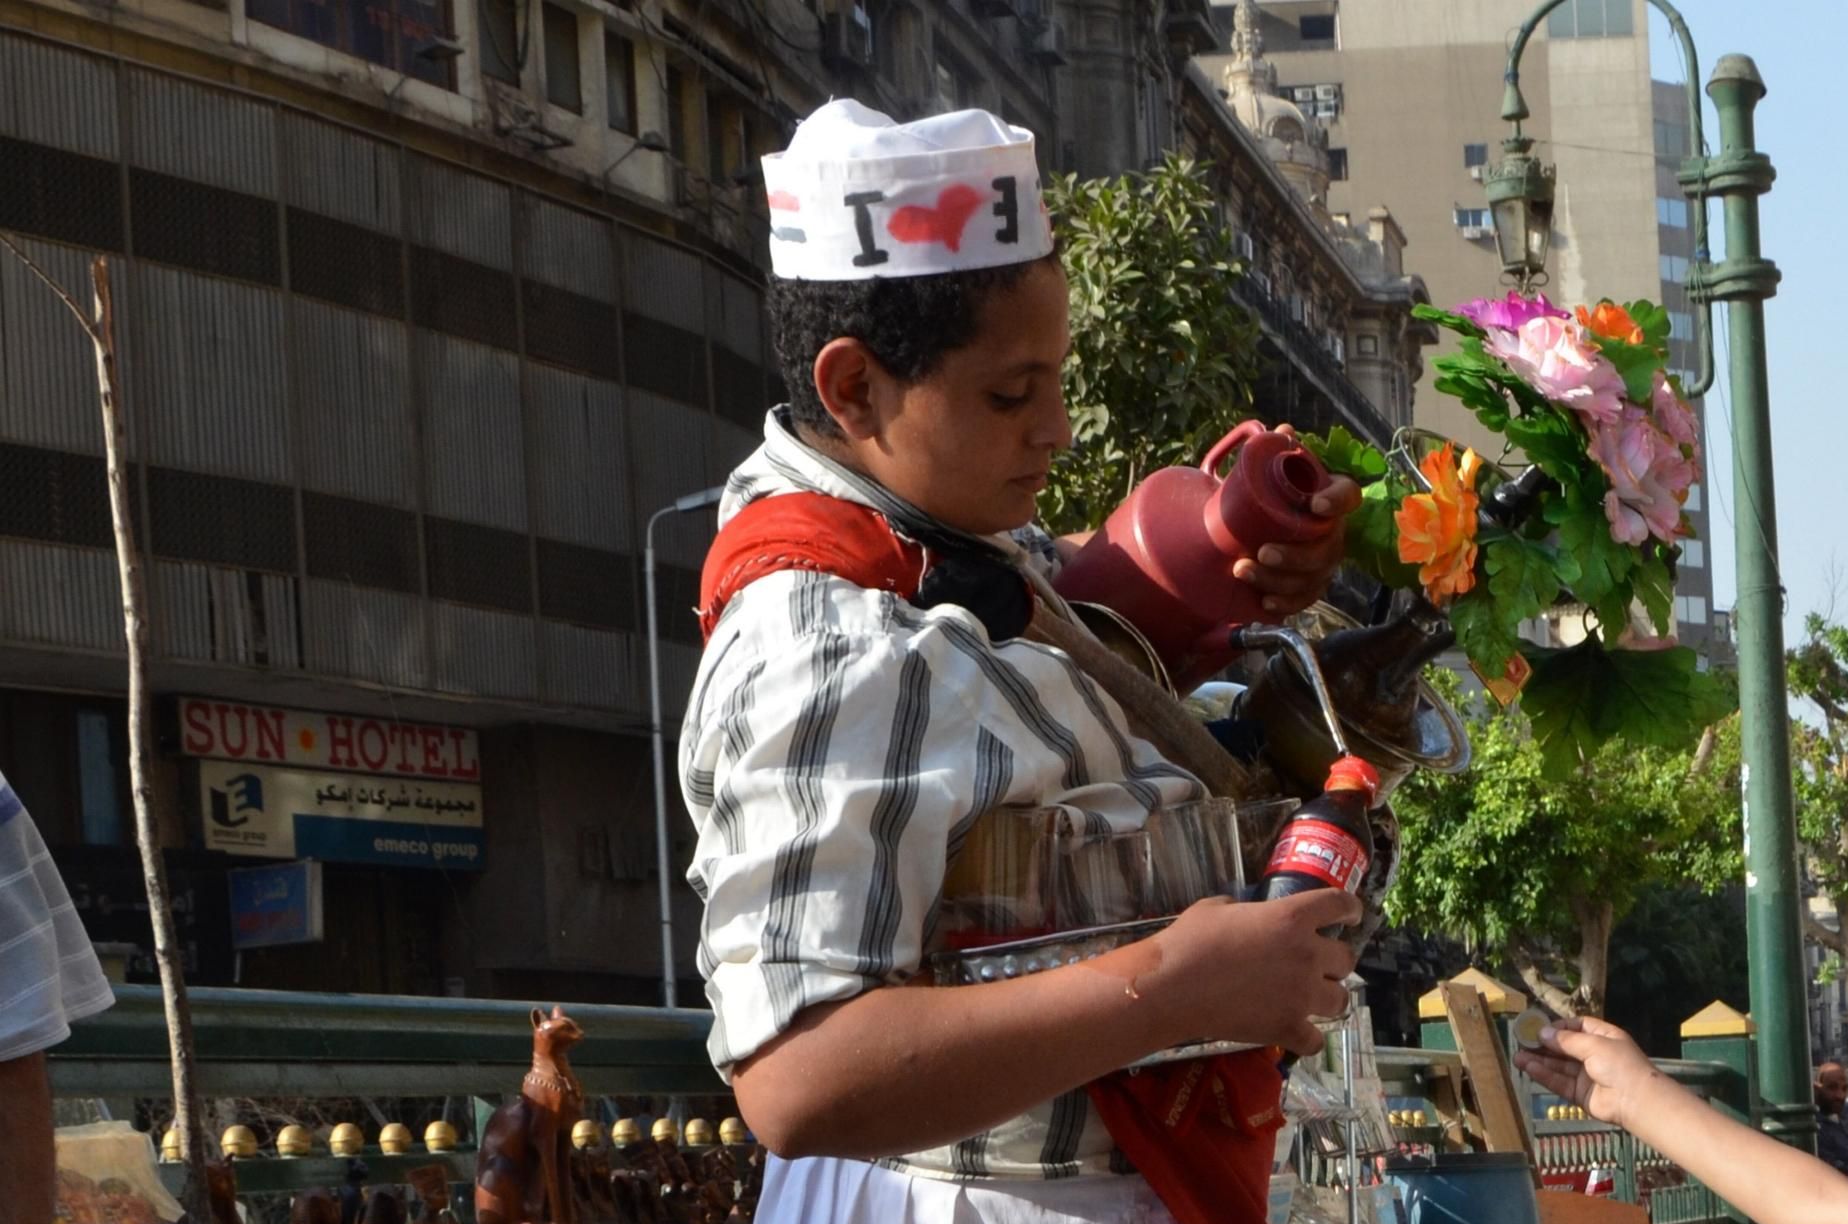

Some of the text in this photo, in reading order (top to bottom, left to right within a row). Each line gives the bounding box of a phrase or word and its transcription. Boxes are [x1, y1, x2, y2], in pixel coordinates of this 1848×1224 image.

[186, 702, 478, 779] SUN HOTEL
[359, 784, 409, 811] شركات
[415, 788, 476, 818] مجموعة
[373, 837, 479, 864] emeco group
